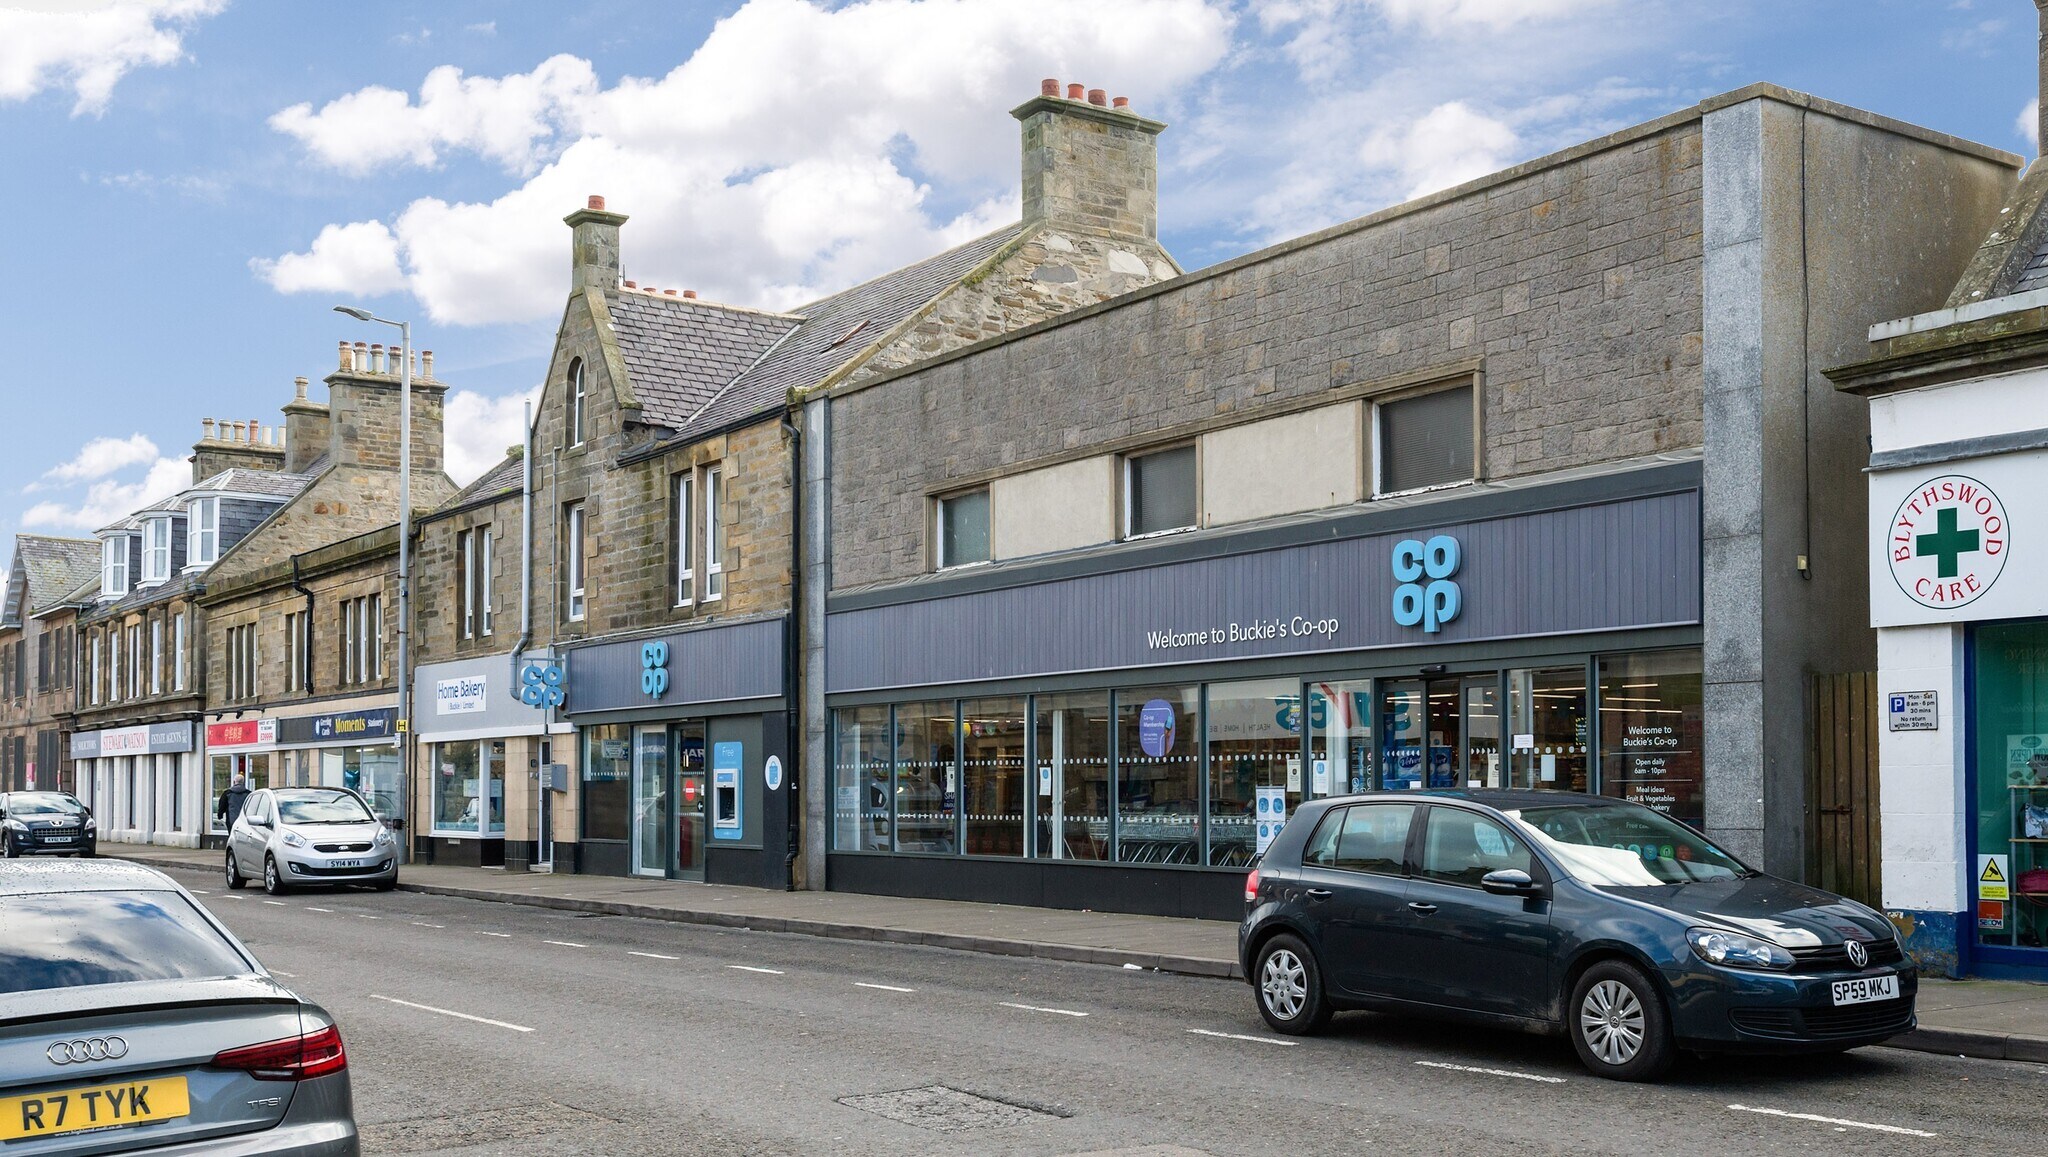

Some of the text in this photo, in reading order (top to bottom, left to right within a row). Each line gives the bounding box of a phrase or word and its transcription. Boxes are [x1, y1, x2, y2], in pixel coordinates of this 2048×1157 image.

[1894, 482, 2003, 563] BLYTHSWOOD
[1915, 573, 1981, 602] CARE
[1147, 616, 1339, 649] Welcome to Buckie's Co-op
[438, 680, 485, 700] Home Bakery
[1894, 699, 1902, 712] P
[335, 716, 366, 733] Moments
[367, 718, 384, 728] Stationery
[1628, 726, 1672, 735] Welcome to
[103, 732, 147, 750] STEWART WATSON
[151, 734, 165, 744] ESTATE
[166, 732, 182, 744] AGENTS
[1623, 737, 1678, 747] Buckie's Co-op
[722, 746, 734, 757] Free
[1652, 758, 1666, 766] daily
[1645, 795, 1675, 804] Vegetables
[1834, 978, 1890, 1001] SP59 MKJ
[21, 1085, 150, 1131] R7 TYK
